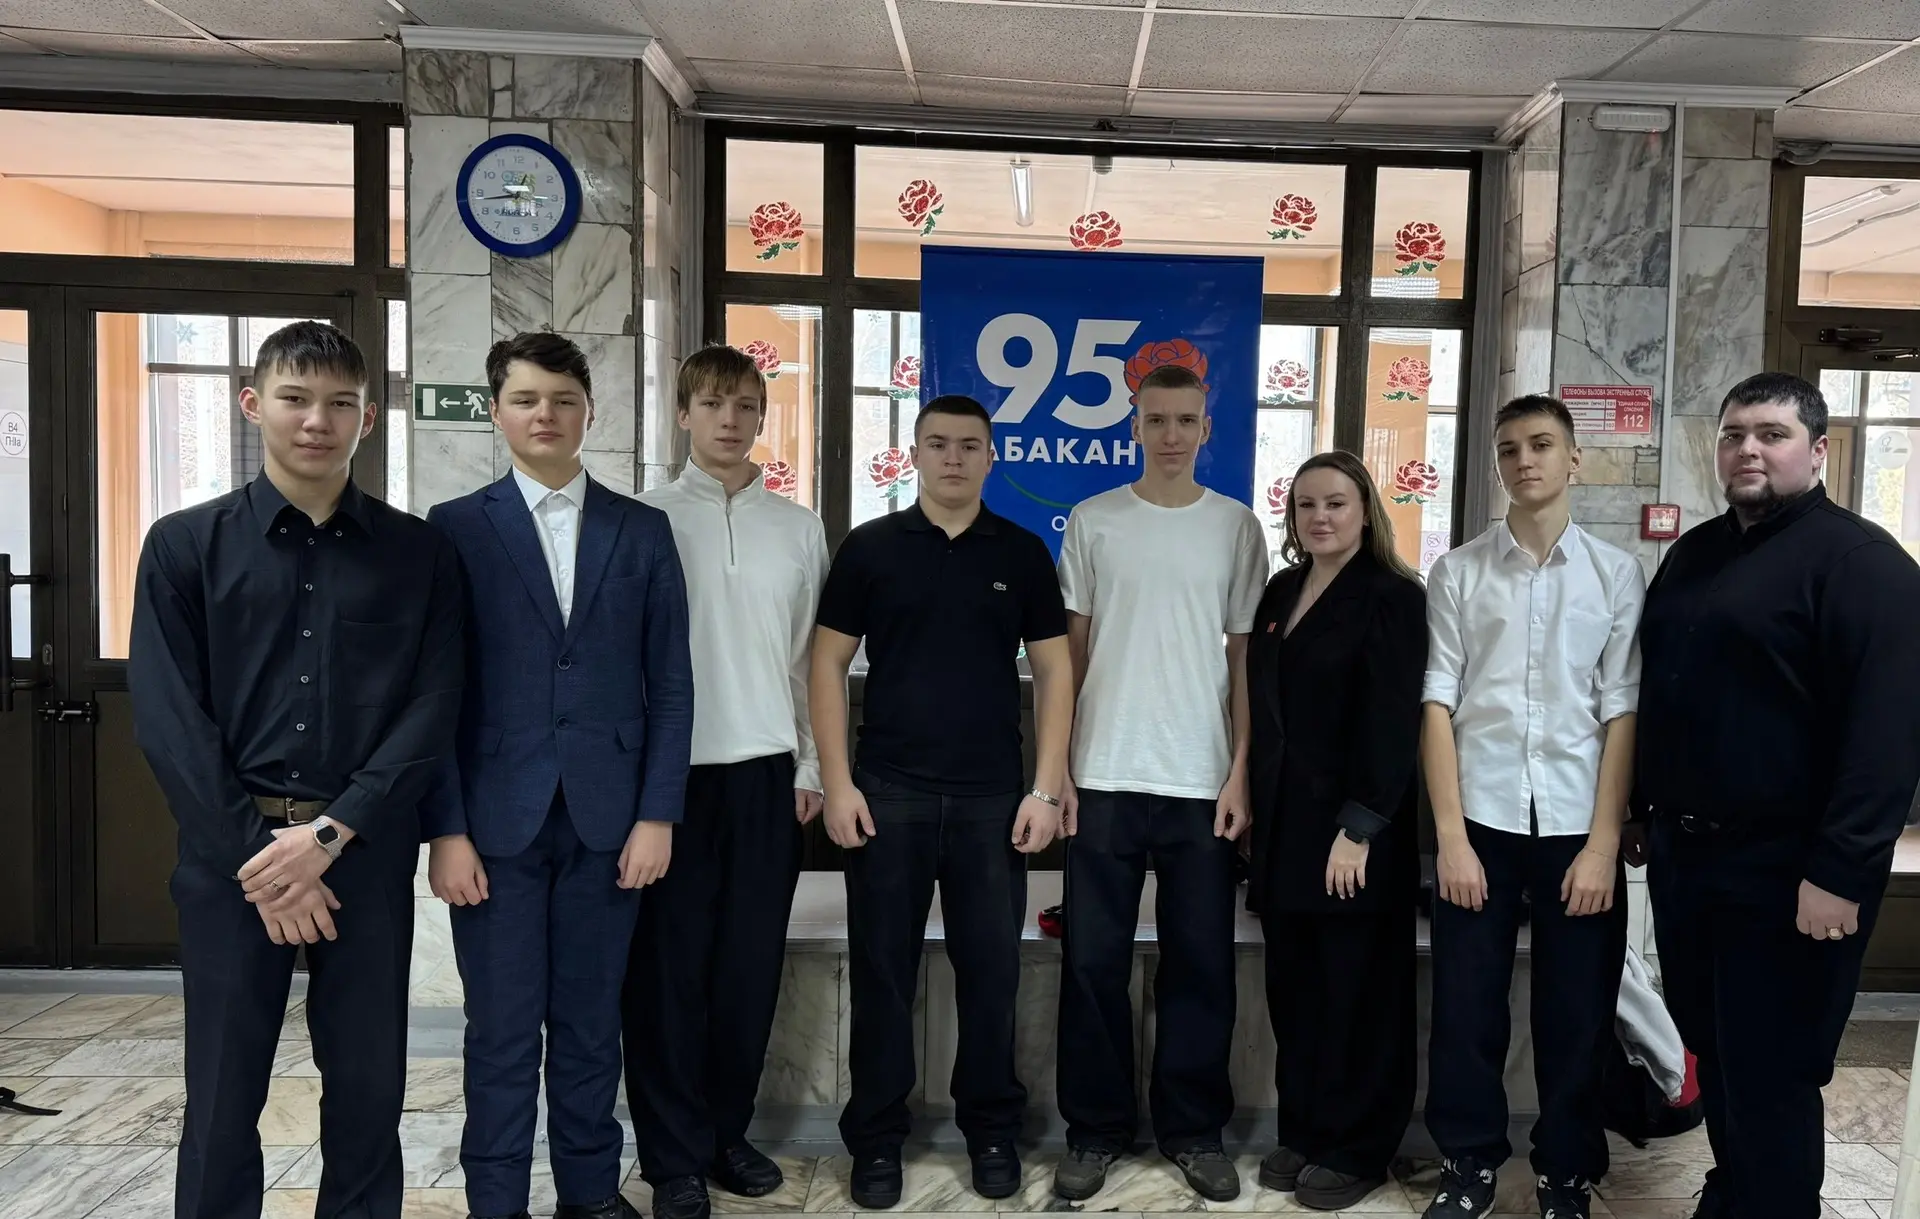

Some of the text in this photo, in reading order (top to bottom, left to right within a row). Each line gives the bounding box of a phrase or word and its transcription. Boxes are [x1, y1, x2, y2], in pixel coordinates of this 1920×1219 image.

[484, 171, 496, 179] 10
[476, 189, 484, 197] 9
[481, 207, 489, 215] 8
[545, 212, 553, 220] 4
[494, 221, 501, 229] 7
[513, 227, 520, 235] 6
[976, 313, 1141, 430] 95
[1563, 388, 1650, 397] ТЕЛЕФОНЫ ВЫЗОВА ЭКСТРЕННЫХ СЛУЖБ
[1623, 414, 1644, 428] 112
